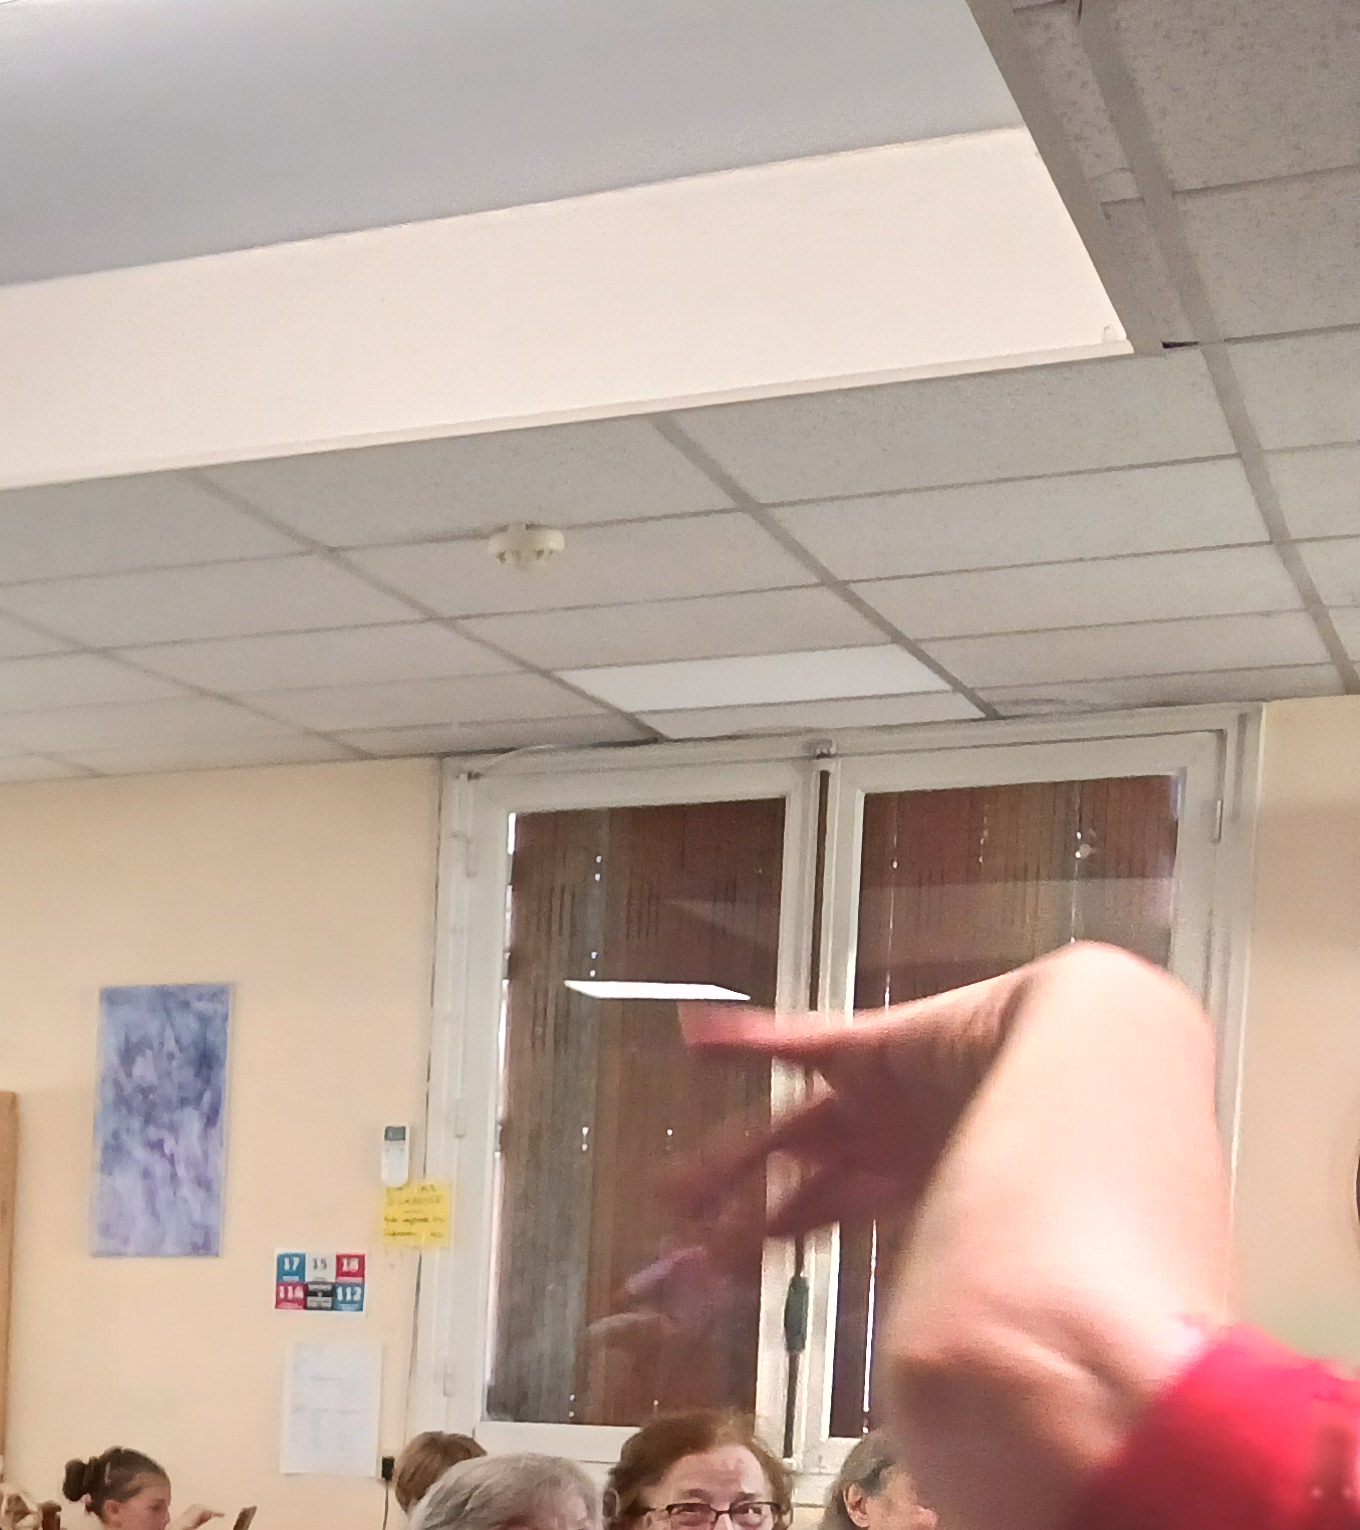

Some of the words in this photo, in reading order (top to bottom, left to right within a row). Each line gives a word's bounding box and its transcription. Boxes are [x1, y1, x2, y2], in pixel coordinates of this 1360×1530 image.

[283, 1256, 300, 1271] 17
[312, 1257, 327, 1271] 15
[342, 1257, 359, 1272] 18
[279, 1285, 304, 1299] 114
[336, 1286, 361, 1301] 112
